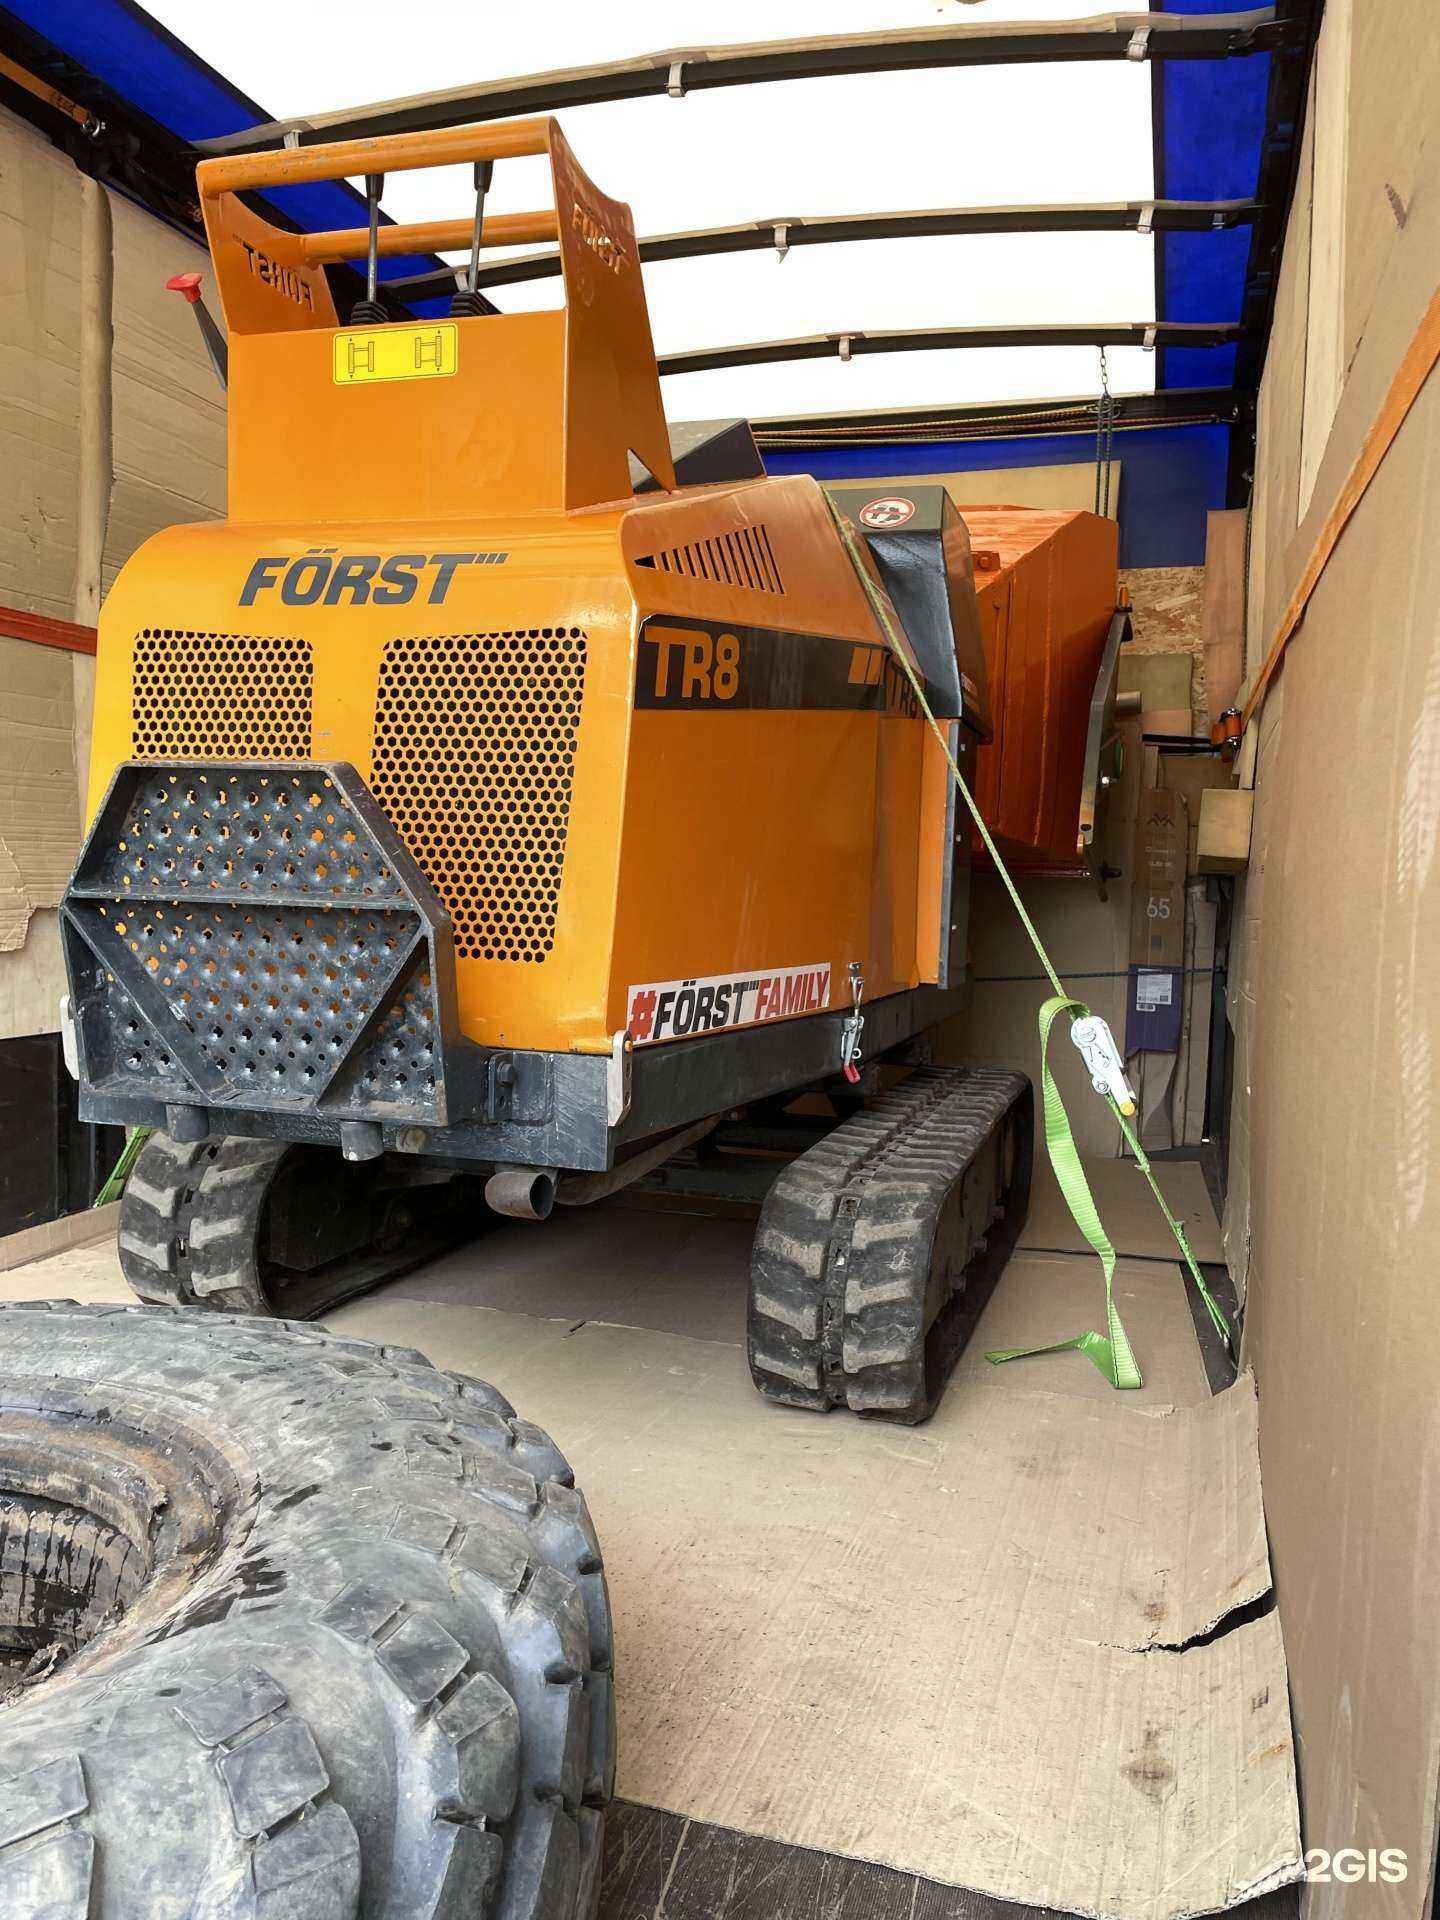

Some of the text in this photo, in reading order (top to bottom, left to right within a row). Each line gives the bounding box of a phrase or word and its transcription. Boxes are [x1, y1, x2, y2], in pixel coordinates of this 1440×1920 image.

[238, 548, 478, 606] FÖRST
[644, 625, 740, 700] TR8
[1146, 897, 1170, 919] 65
